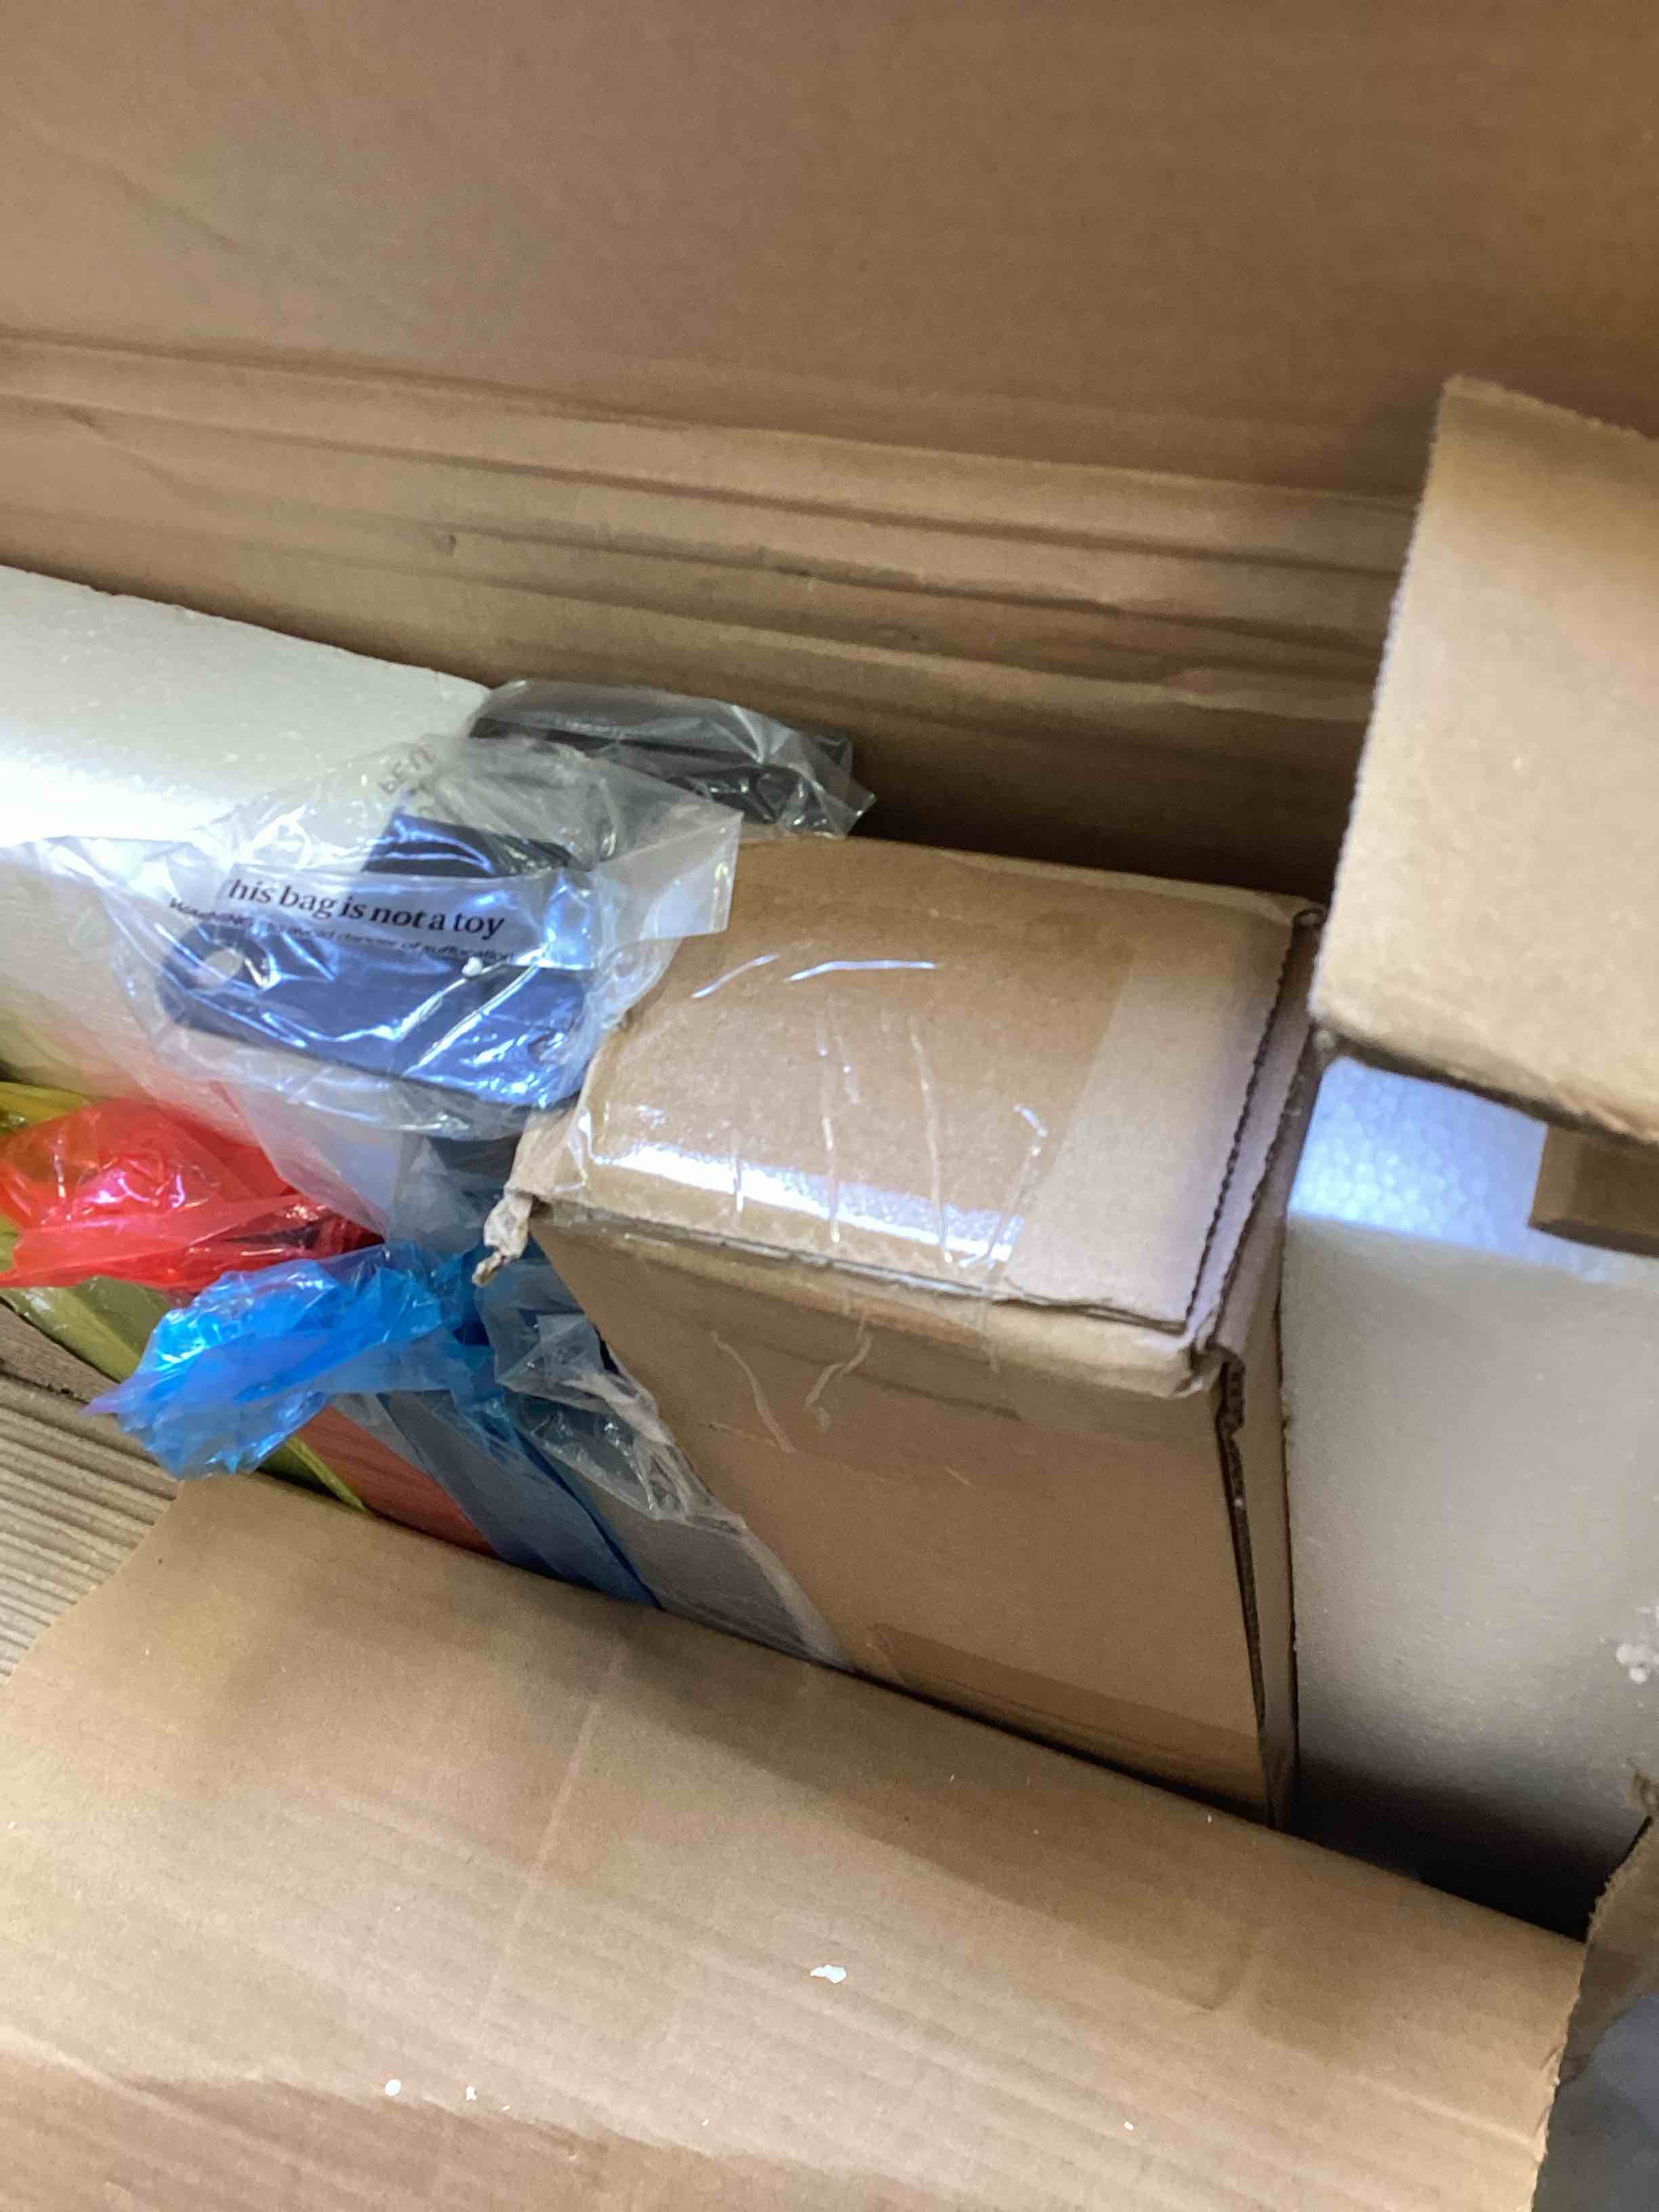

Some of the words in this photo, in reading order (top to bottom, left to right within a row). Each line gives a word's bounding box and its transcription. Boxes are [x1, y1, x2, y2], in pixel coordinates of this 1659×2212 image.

[224, 878, 272, 904] his
[278, 884, 337, 920] bag
[338, 895, 367, 919] is
[369, 906, 427, 930] not
[427, 912, 447, 931] a
[453, 912, 505, 941] toy
